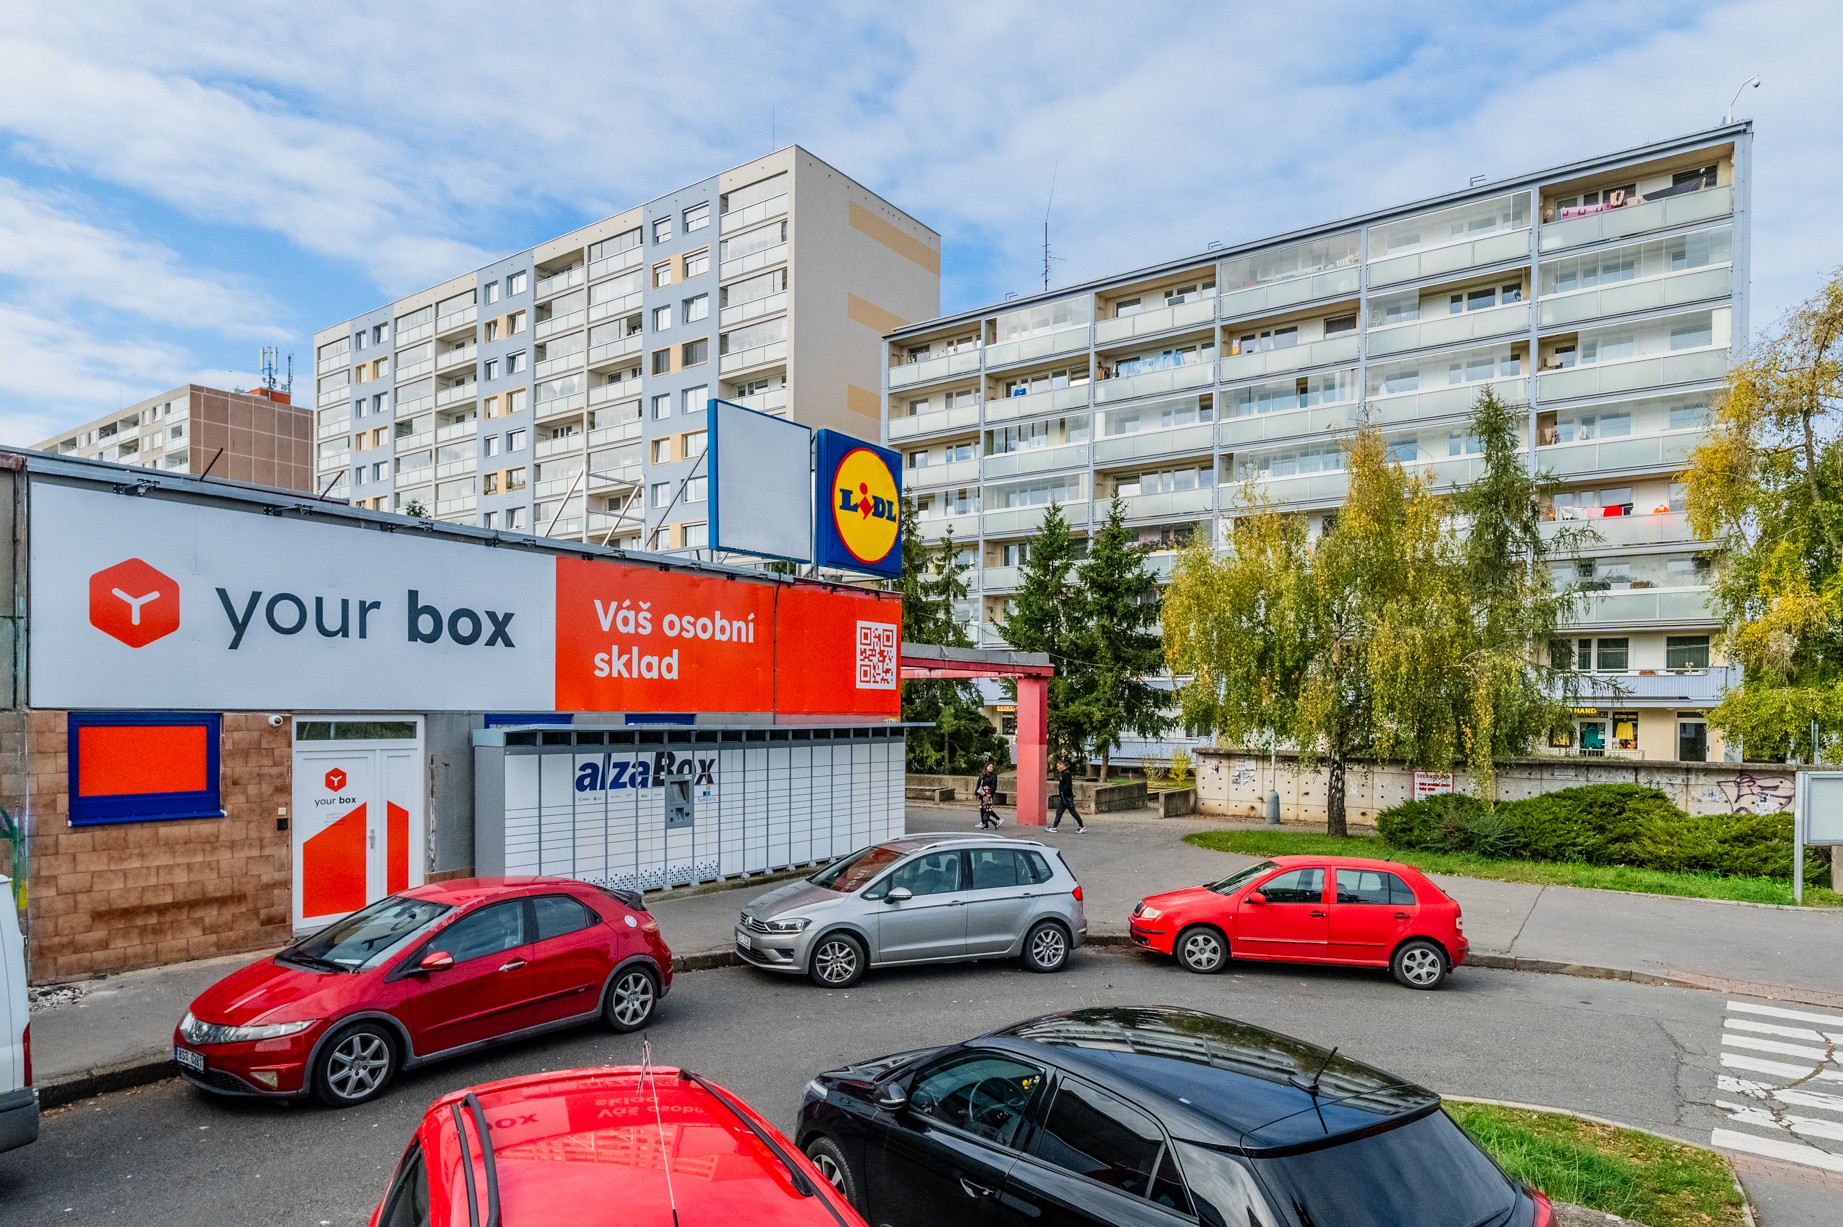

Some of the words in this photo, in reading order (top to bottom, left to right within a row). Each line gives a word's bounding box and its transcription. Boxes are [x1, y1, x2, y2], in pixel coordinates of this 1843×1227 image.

[215, 588, 382, 650] your
[407, 588, 516, 649] box
[594, 599, 653, 636] Váš
[662, 610, 755, 644] osobní
[594, 644, 679, 680] sklad
[315, 798, 336, 808] your
[339, 796, 357, 805] box
